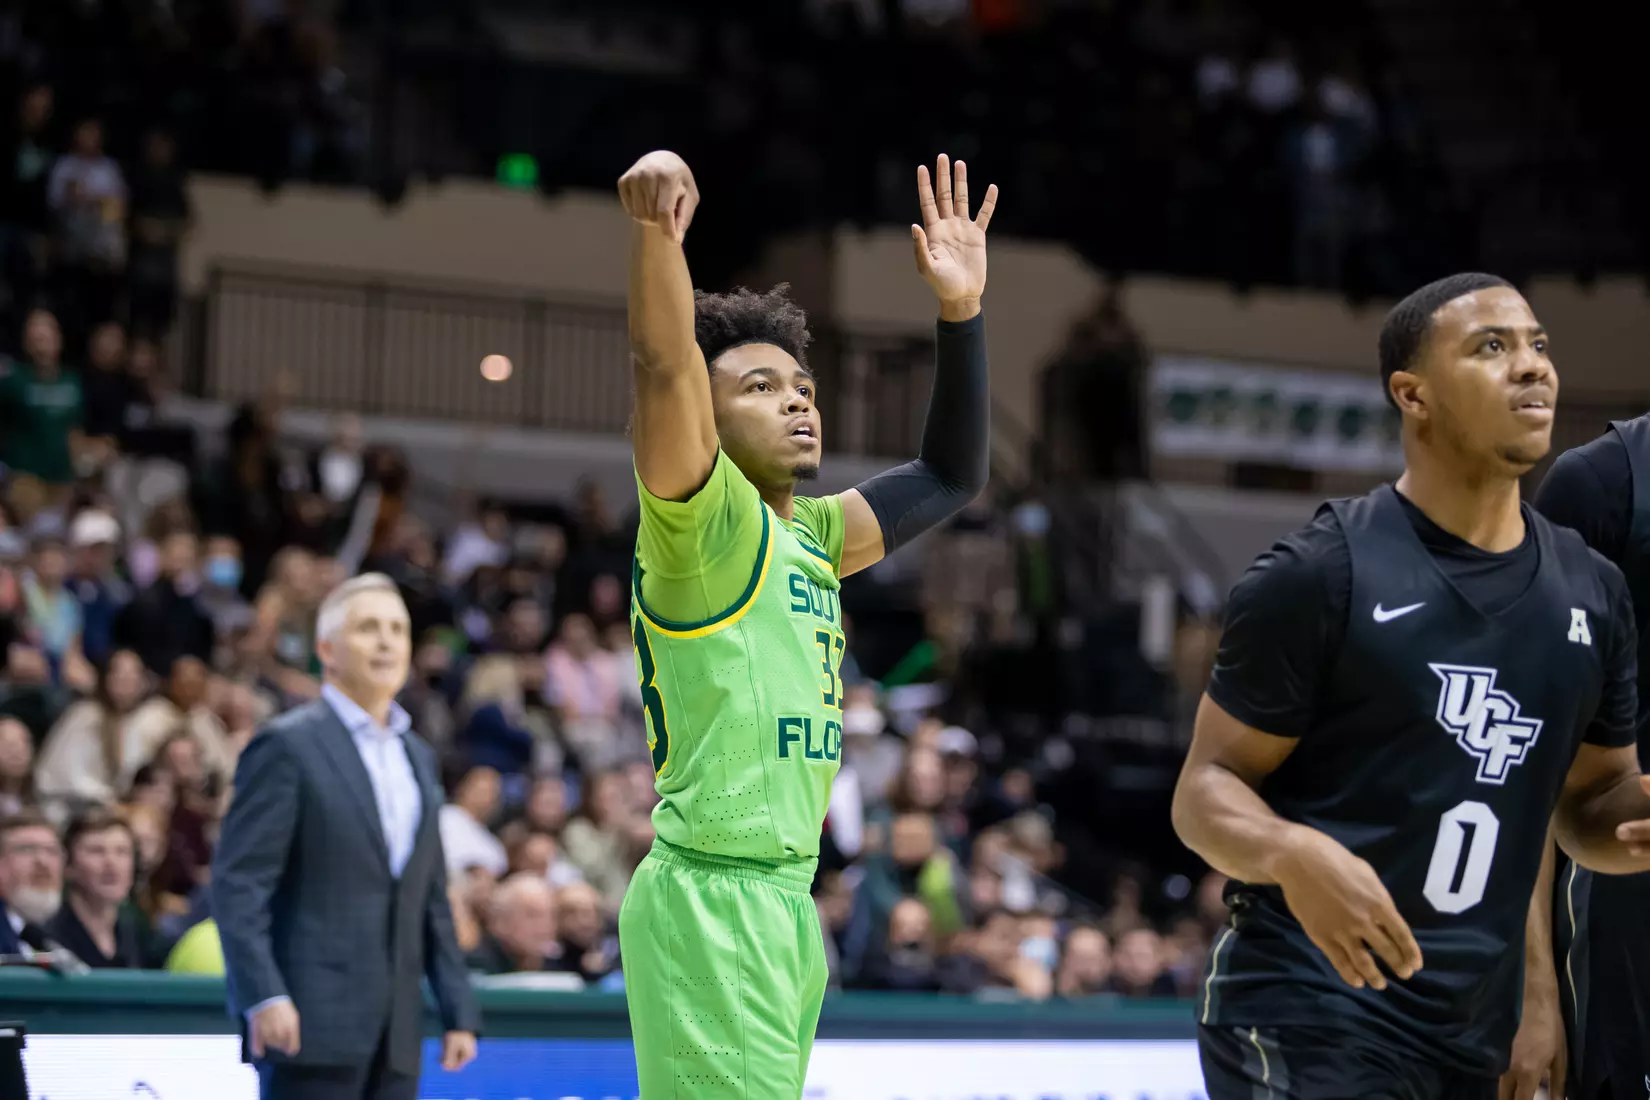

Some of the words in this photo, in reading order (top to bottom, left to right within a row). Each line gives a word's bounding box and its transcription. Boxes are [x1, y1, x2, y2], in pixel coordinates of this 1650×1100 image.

[1567, 607, 1592, 646] A
[1427, 662, 1544, 785] UCF
[1422, 800, 1500, 914] 0
